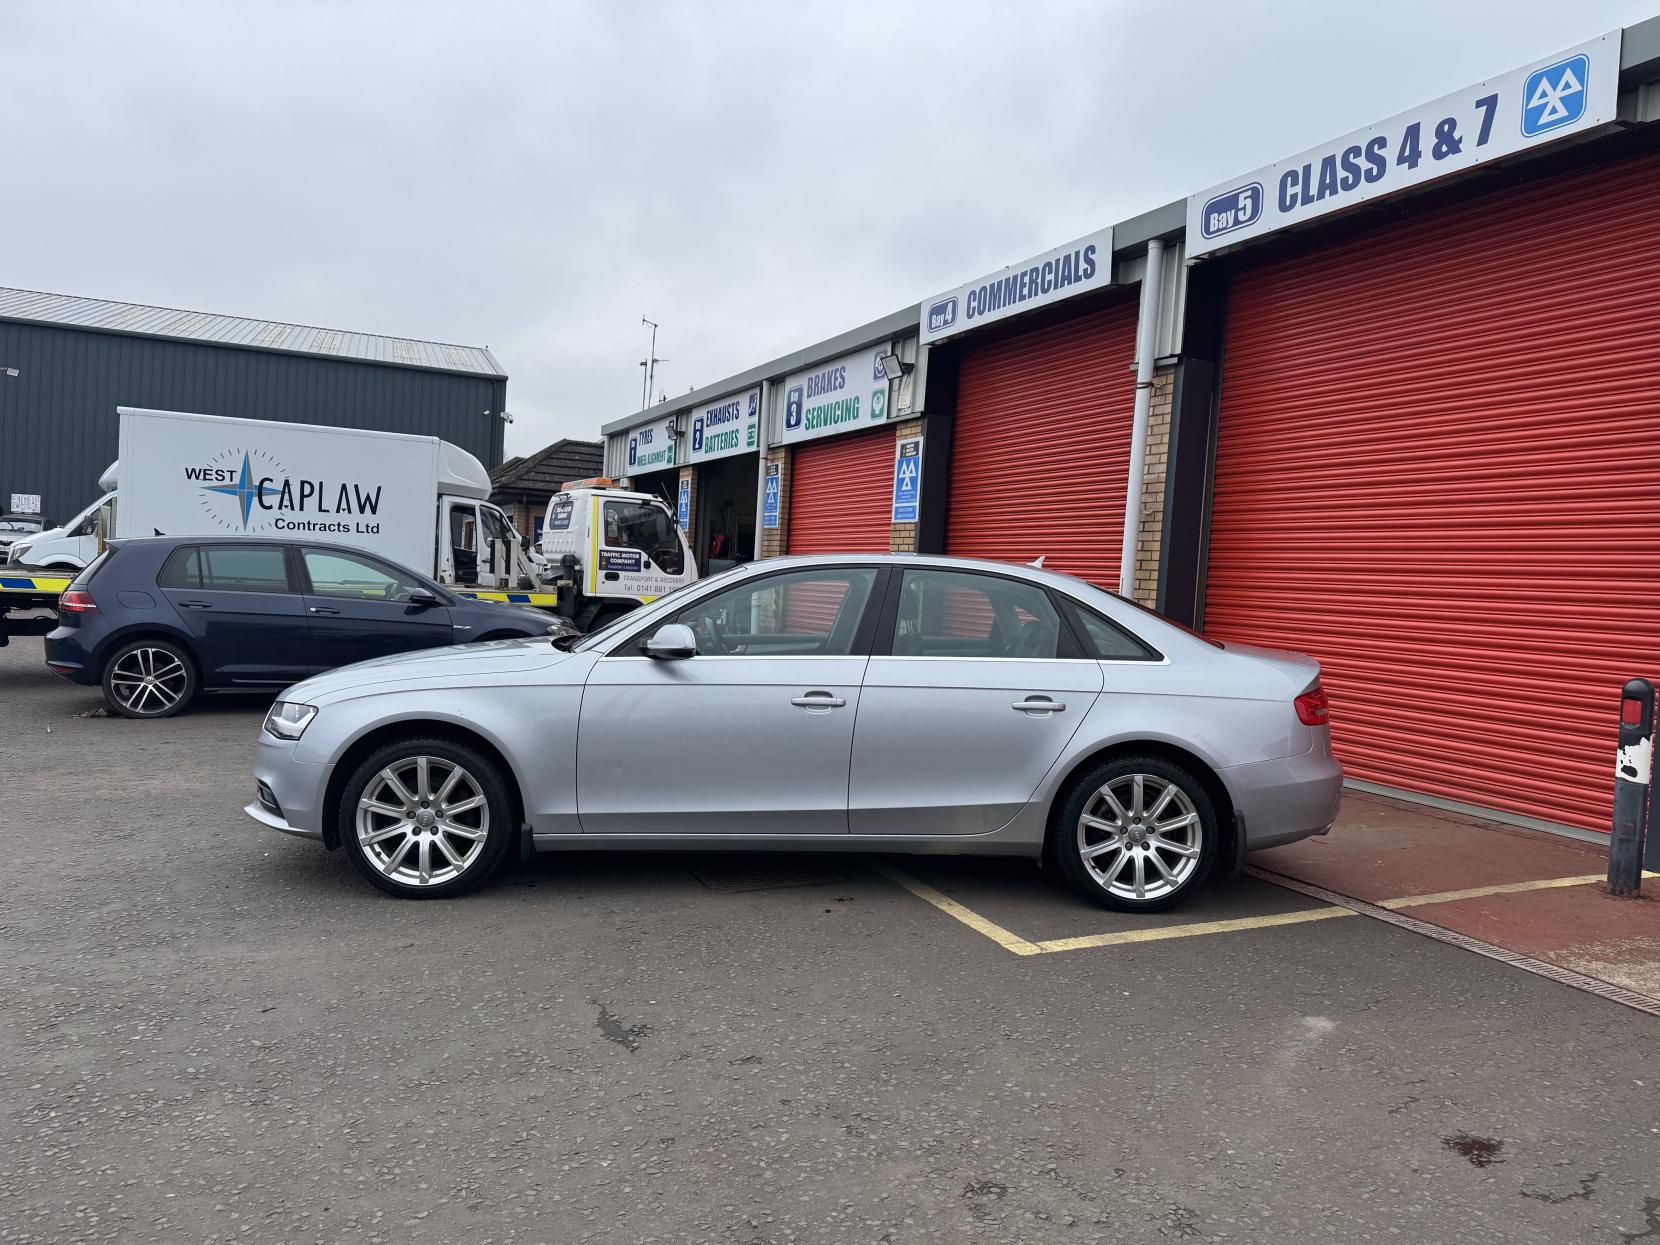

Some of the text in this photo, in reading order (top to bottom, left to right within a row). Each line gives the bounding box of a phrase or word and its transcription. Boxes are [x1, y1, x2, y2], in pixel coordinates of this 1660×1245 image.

[1277, 93, 1499, 213] CLASS 4 & 7
[1209, 191, 1253, 232] Bay 5
[966, 244, 1096, 319] COMMERCIALS
[931, 301, 953, 328] Bay 4
[806, 365, 846, 398] BRAKES
[706, 401, 740, 428] EXHAUSTS
[790, 404, 797, 426] 3
[804, 396, 860, 431] SERVICING
[639, 428, 653, 446] TYRES
[695, 431, 700, 448] 2
[704, 429, 739, 454] BATTERIES
[185, 467, 237, 482] WEST
[257, 477, 382, 515] CAPLAW
[274, 517, 380, 534] Contracts Ltd
[624, 575, 653, 583] TRANSPORT
